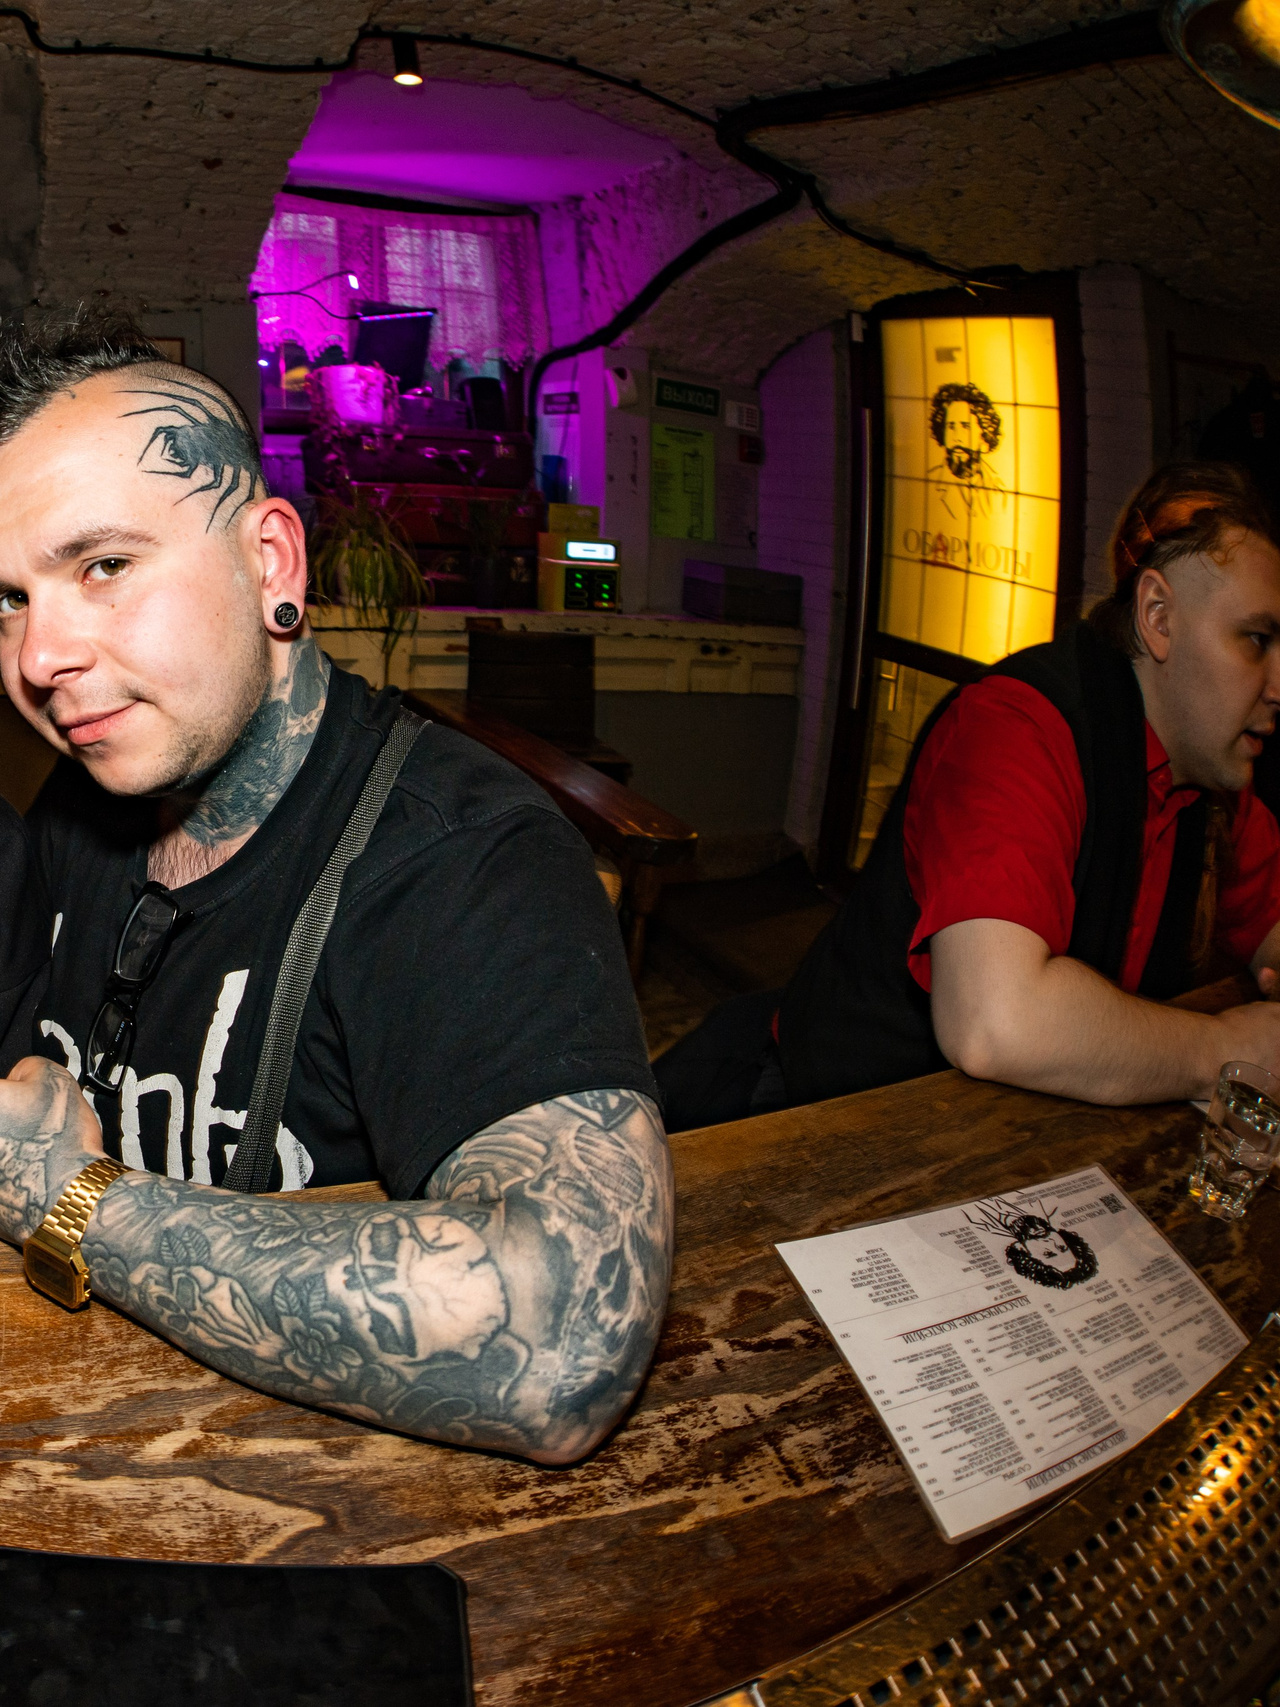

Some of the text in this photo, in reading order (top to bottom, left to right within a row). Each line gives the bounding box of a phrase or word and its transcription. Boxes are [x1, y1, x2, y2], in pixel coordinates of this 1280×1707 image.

[662, 385, 716, 410] ВЫХОД
[956, 1296, 1031, 1327] КЛАССИЧЕСКИЕ
[901, 1321, 958, 1344] КОКТЕЙЛИ
